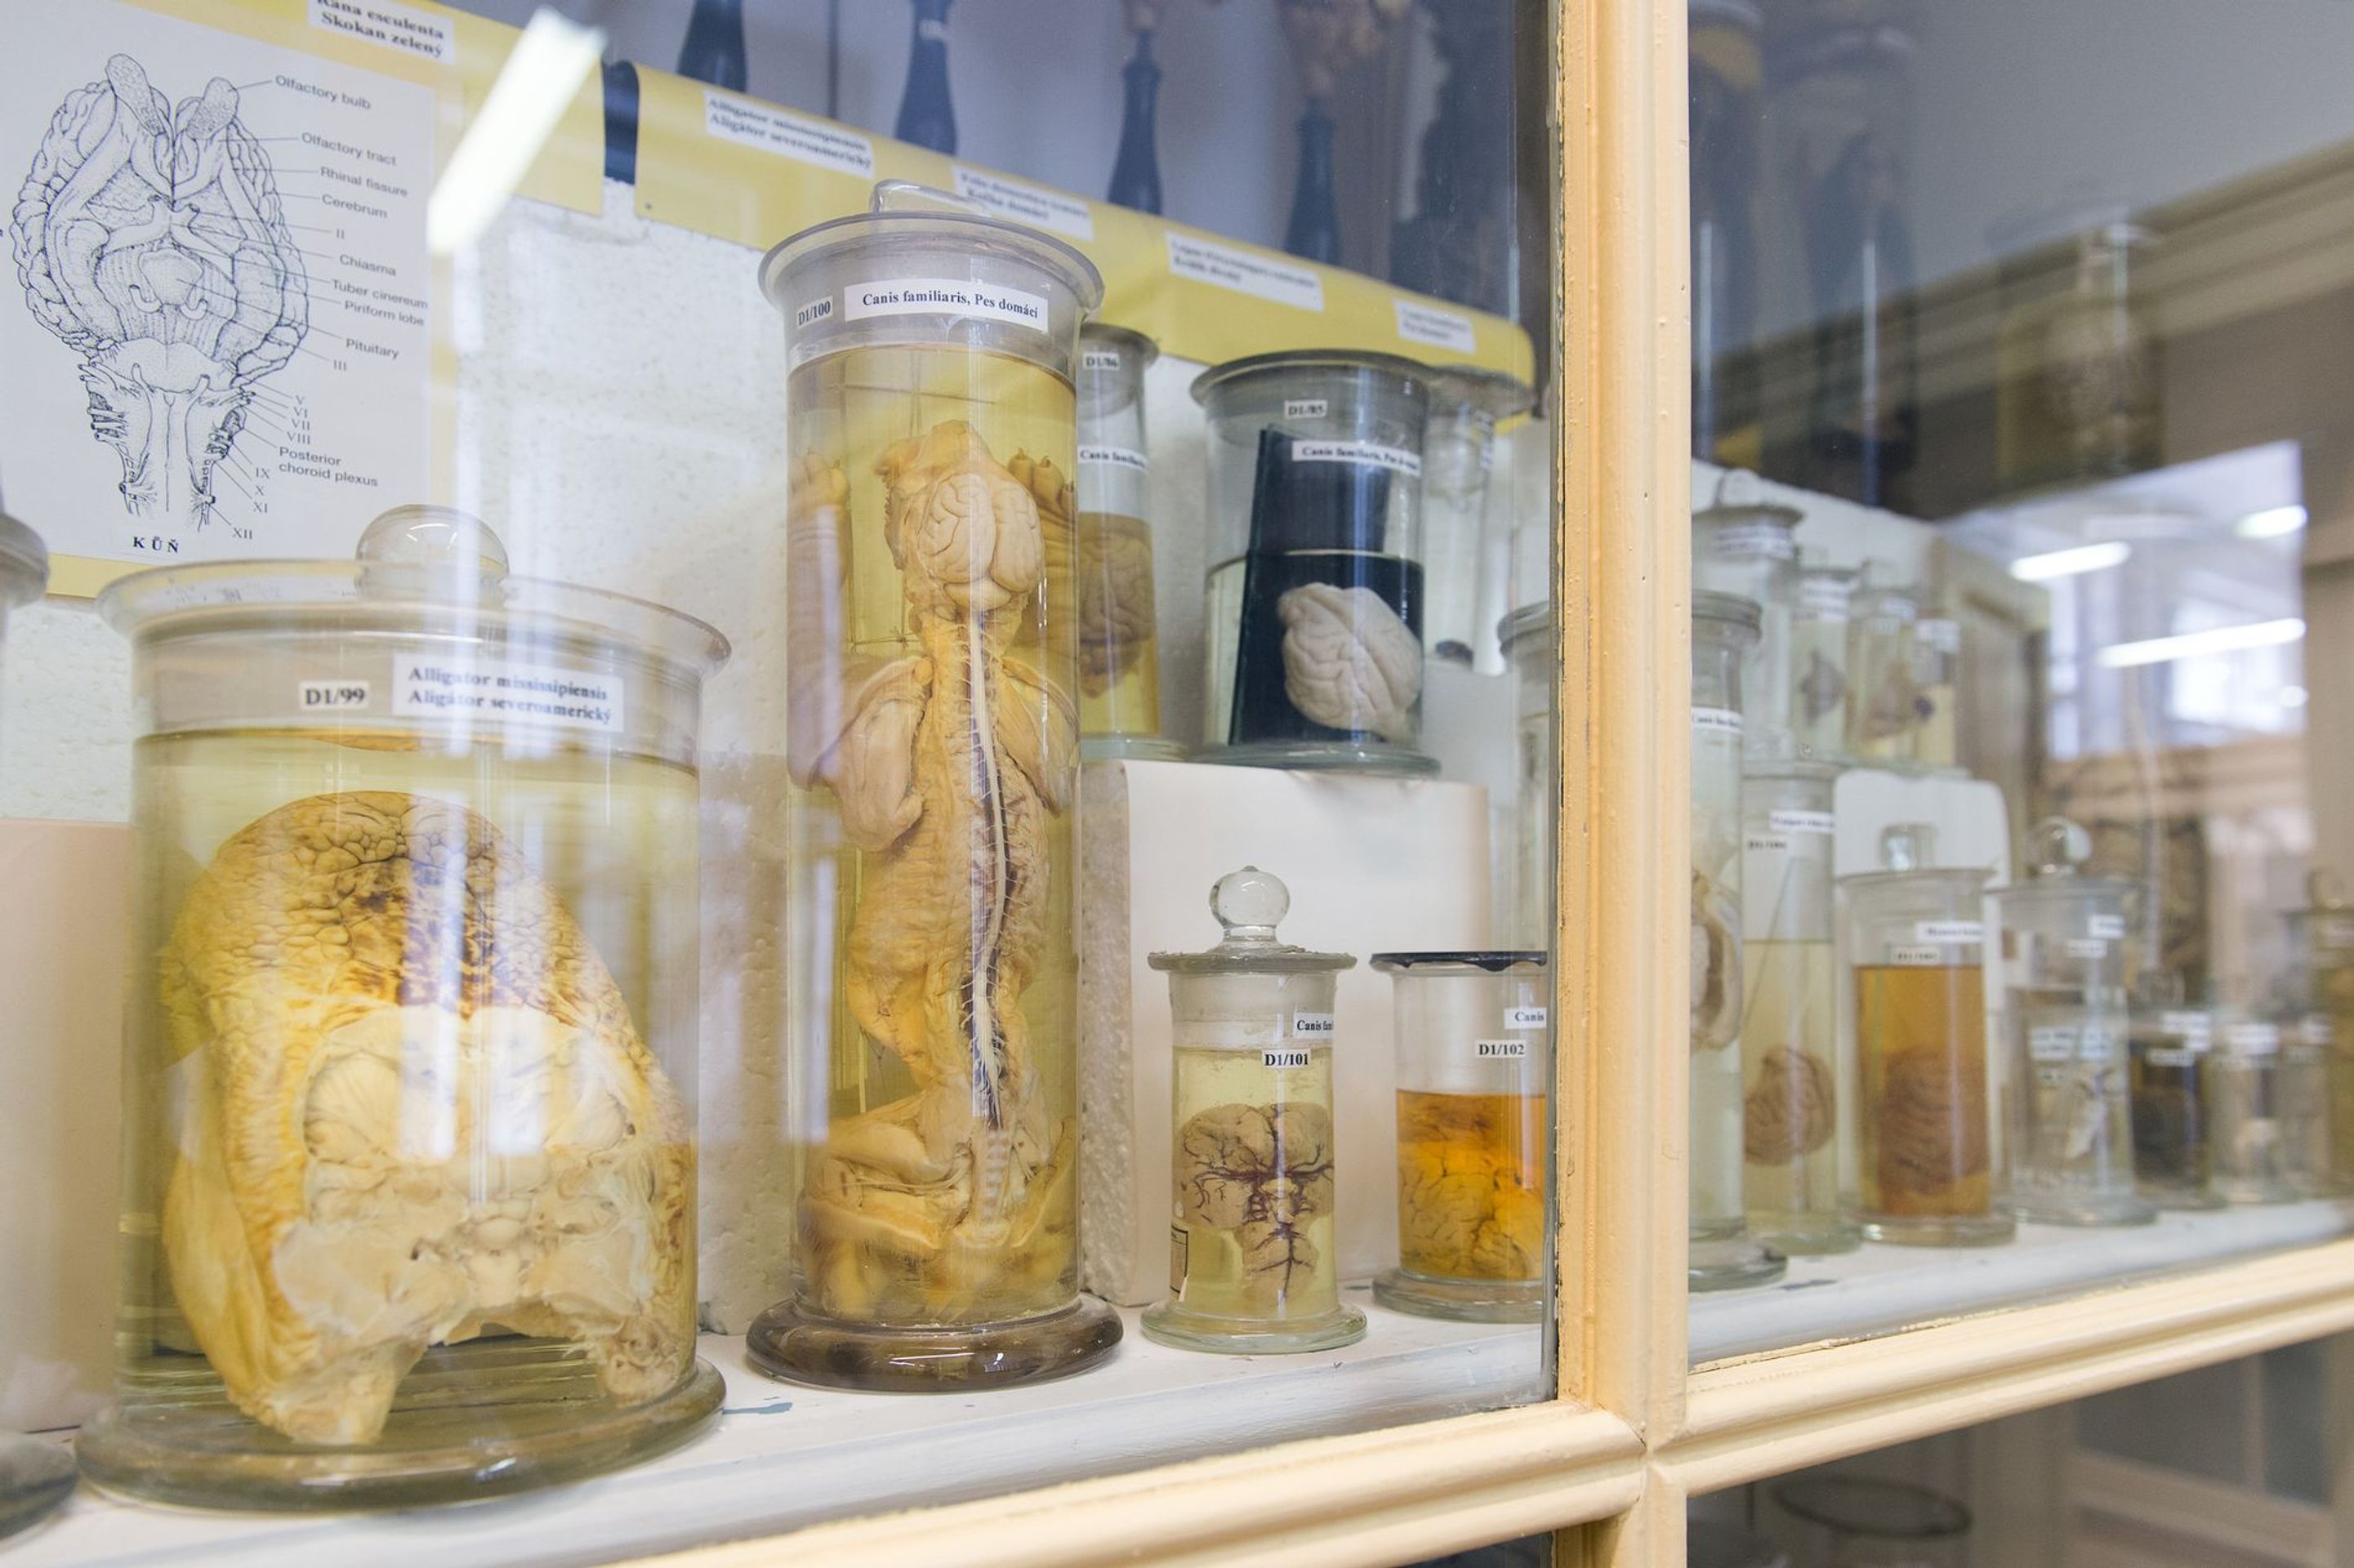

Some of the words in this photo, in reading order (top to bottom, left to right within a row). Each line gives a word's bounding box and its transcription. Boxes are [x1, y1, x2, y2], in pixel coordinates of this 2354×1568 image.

[368, 10, 444, 39] esculenta
[321, 11, 386, 40] Skokan
[390, 33, 444, 58] zelený
[275, 74, 338, 103] Olfactory
[341, 92, 371, 109] bulb
[301, 131, 363, 158] Olfactory
[366, 149, 397, 166] tract
[320, 166, 362, 186] Rhinal
[366, 177, 408, 197] fissure
[322, 194, 388, 219] Cerebrum
[336, 228, 346, 239] II
[339, 253, 397, 277] Chiasma
[332, 278, 368, 296] Tuber
[372, 289, 429, 310] cinereum
[344, 300, 396, 320] Piriform
[399, 311, 425, 326] lobe
[797, 300, 831, 326] D1/100
[863, 292, 899, 306] Canis
[903, 290, 971, 305] familiaris,
[974, 293, 996, 307] Pes
[998, 298, 1039, 318] domácí
[346, 336, 399, 360] Pituitary
[333, 359, 347, 372] III
[295, 394, 305, 405] V
[293, 406, 308, 418] VI
[291, 417, 310, 431] VII
[287, 430, 311, 445] VIII
[279, 446, 342, 466] Posterior
[255, 467, 270, 479] IX
[279, 462, 331, 480] choroid
[335, 471, 378, 488] plexus
[254, 485, 265, 496] X
[253, 501, 268, 513] XI
[232, 527, 253, 540] XII
[408, 667, 491, 685] Alligator
[305, 688, 366, 706] D1/99
[408, 689, 484, 708] Aligátor
[491, 697, 612, 724] severoamerický
[1297, 1020, 1322, 1031] Canis
[1514, 1011, 1545, 1022] Canis
[1478, 1044, 1525, 1056] D1/102
[1264, 1053, 1309, 1067] D1/101
